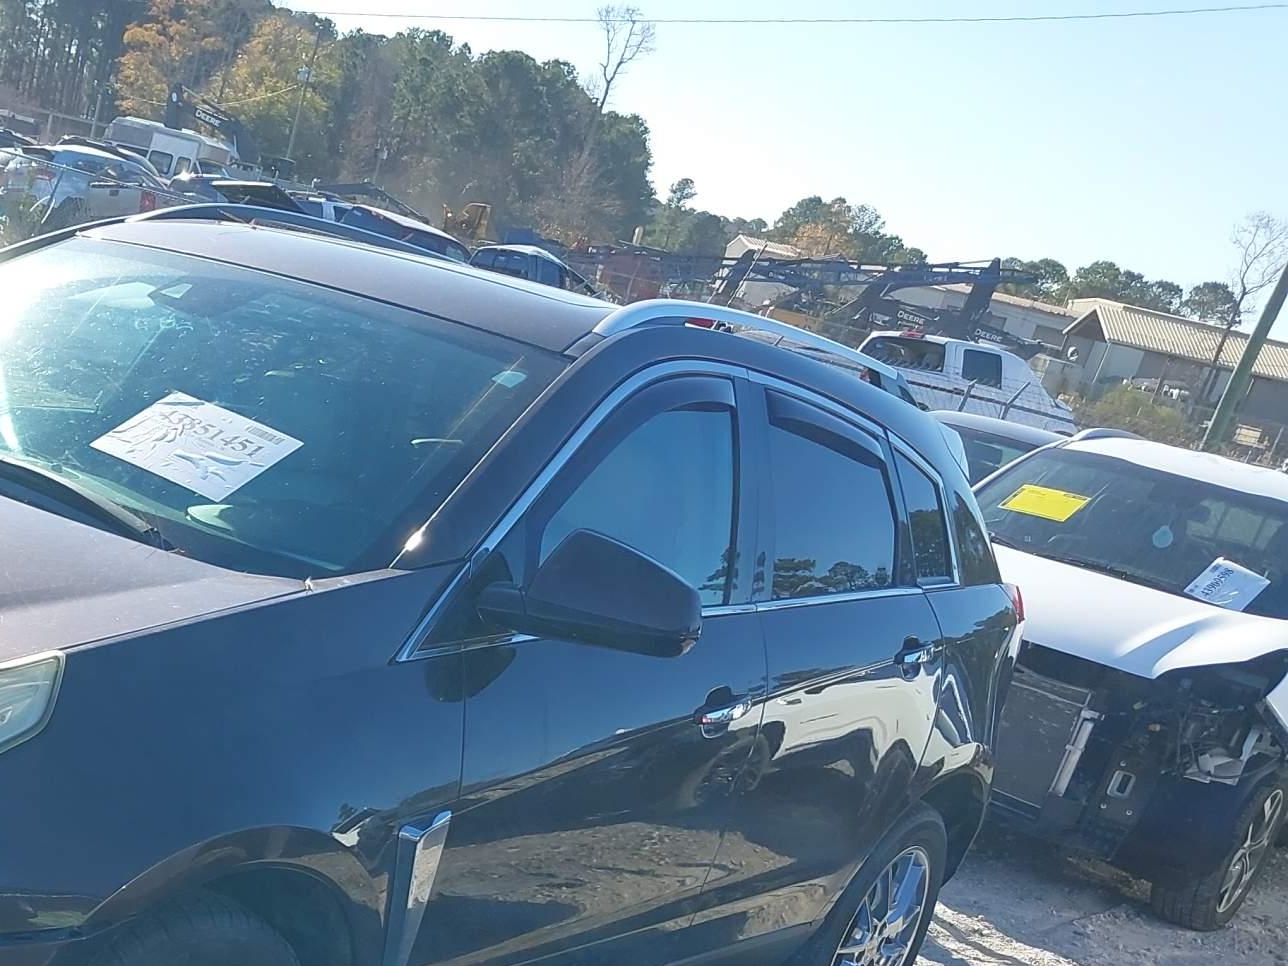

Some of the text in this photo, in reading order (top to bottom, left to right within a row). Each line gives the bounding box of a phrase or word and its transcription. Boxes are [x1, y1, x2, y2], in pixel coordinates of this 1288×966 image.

[195, 109, 222, 127] DEERE
[896, 310, 924, 325] DEERE
[974, 328, 1004, 343] DEERE
